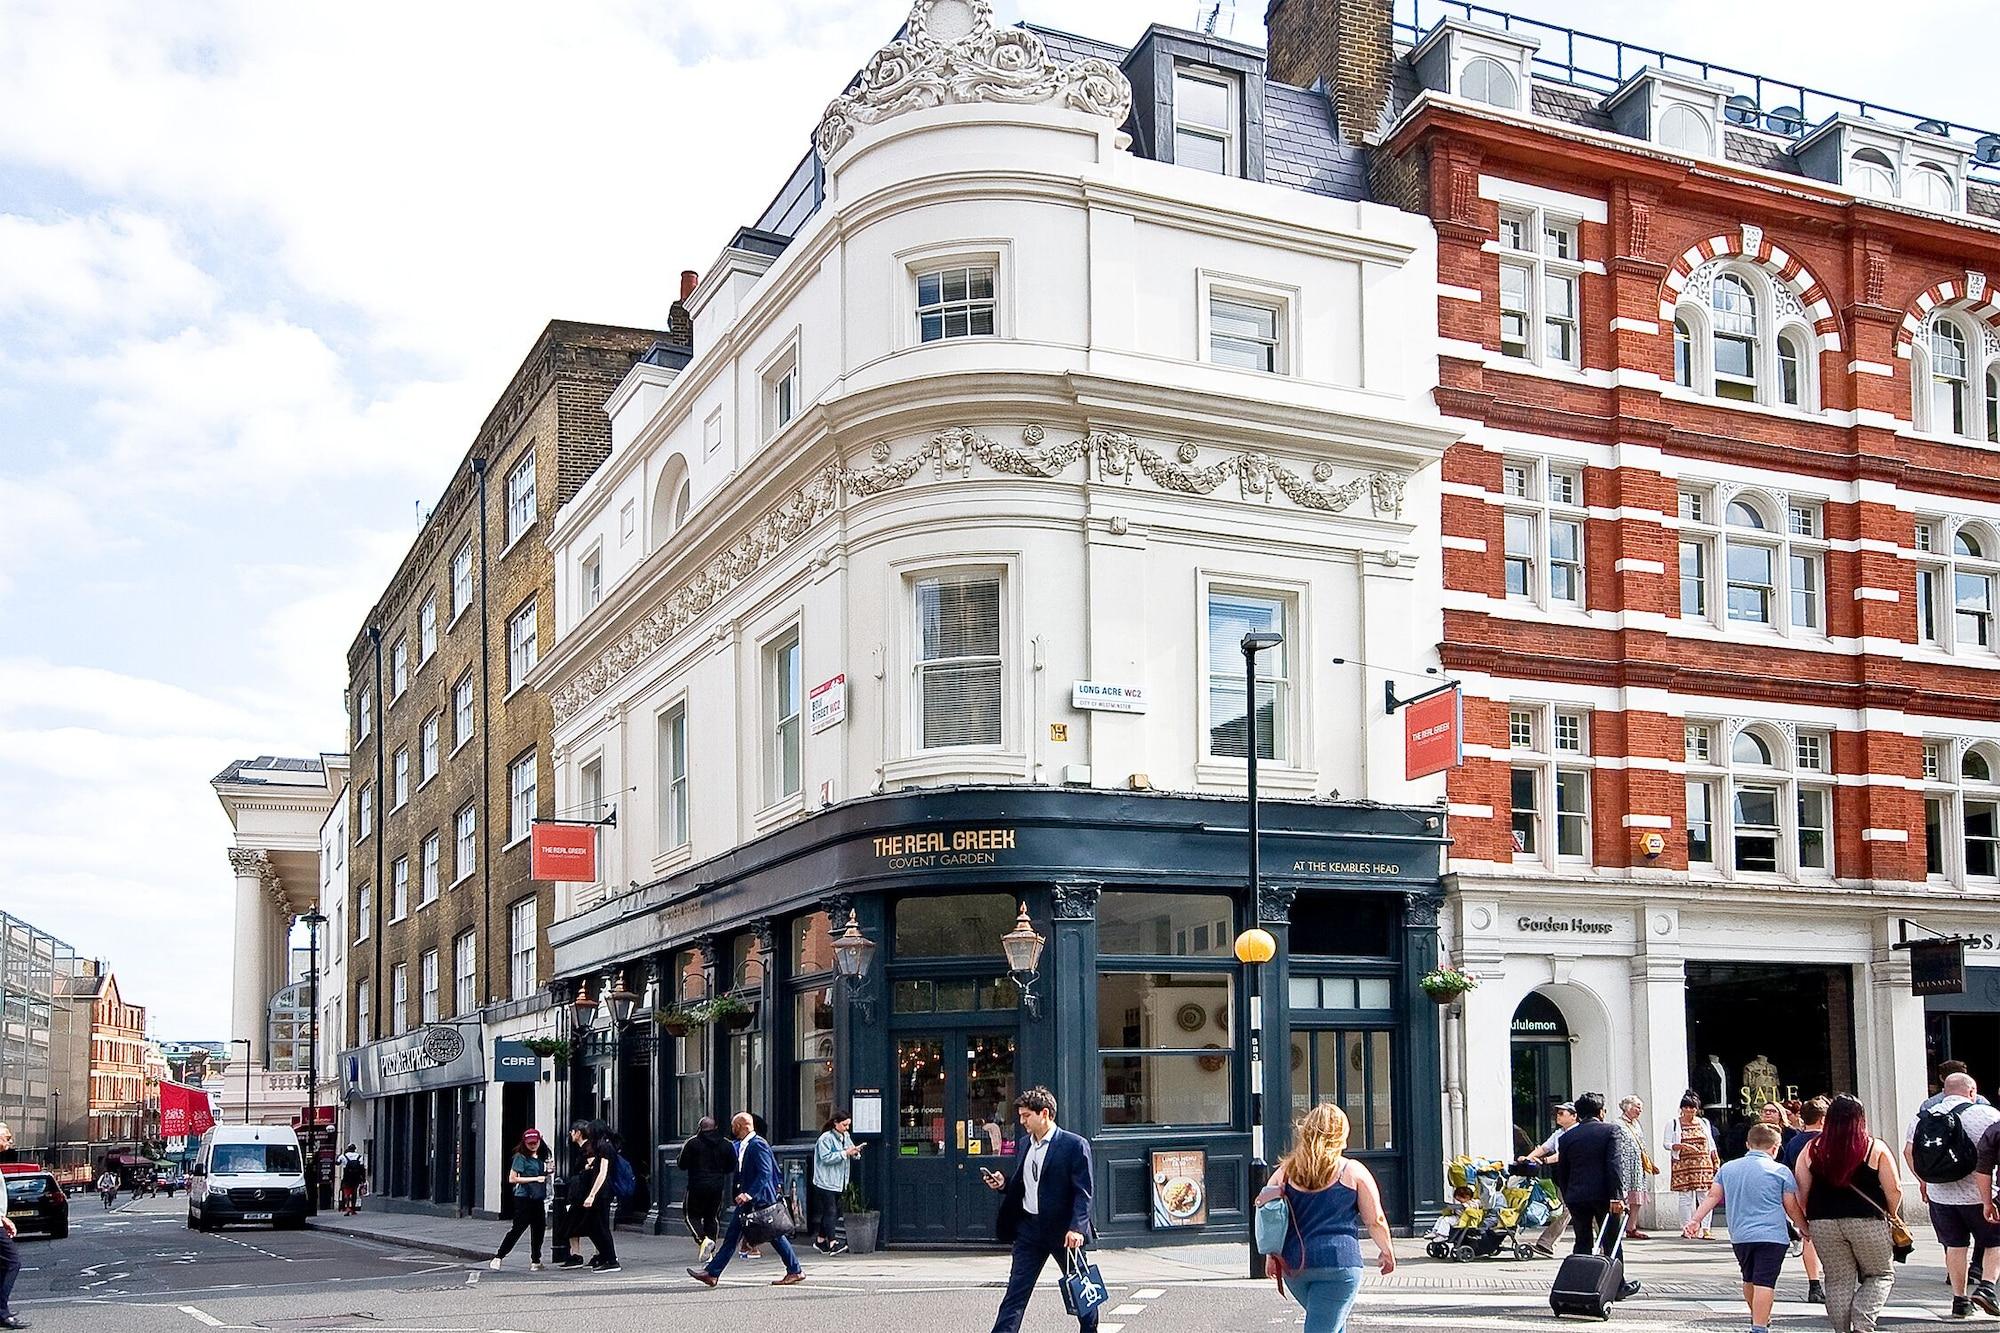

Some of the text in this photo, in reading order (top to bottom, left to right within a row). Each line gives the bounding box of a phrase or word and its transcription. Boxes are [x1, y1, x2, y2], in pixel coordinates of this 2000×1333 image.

[1079, 685, 1142, 698] LONG ACRE WC2
[812, 705, 829, 722] STREET
[541, 846, 587, 855] THE REAL GREEK
[873, 829, 1016, 857] THE REAL GREEK
[889, 852, 995, 870] COVENT GARDEN
[1293, 861, 1399, 874] AT THE KEMBLES HEAD
[1517, 916, 1613, 934] Garden House
[1511, 1019, 1556, 1030] ululemon
[502, 1057, 535, 1066] CBRE
[1740, 1085, 1799, 1105] SALE
